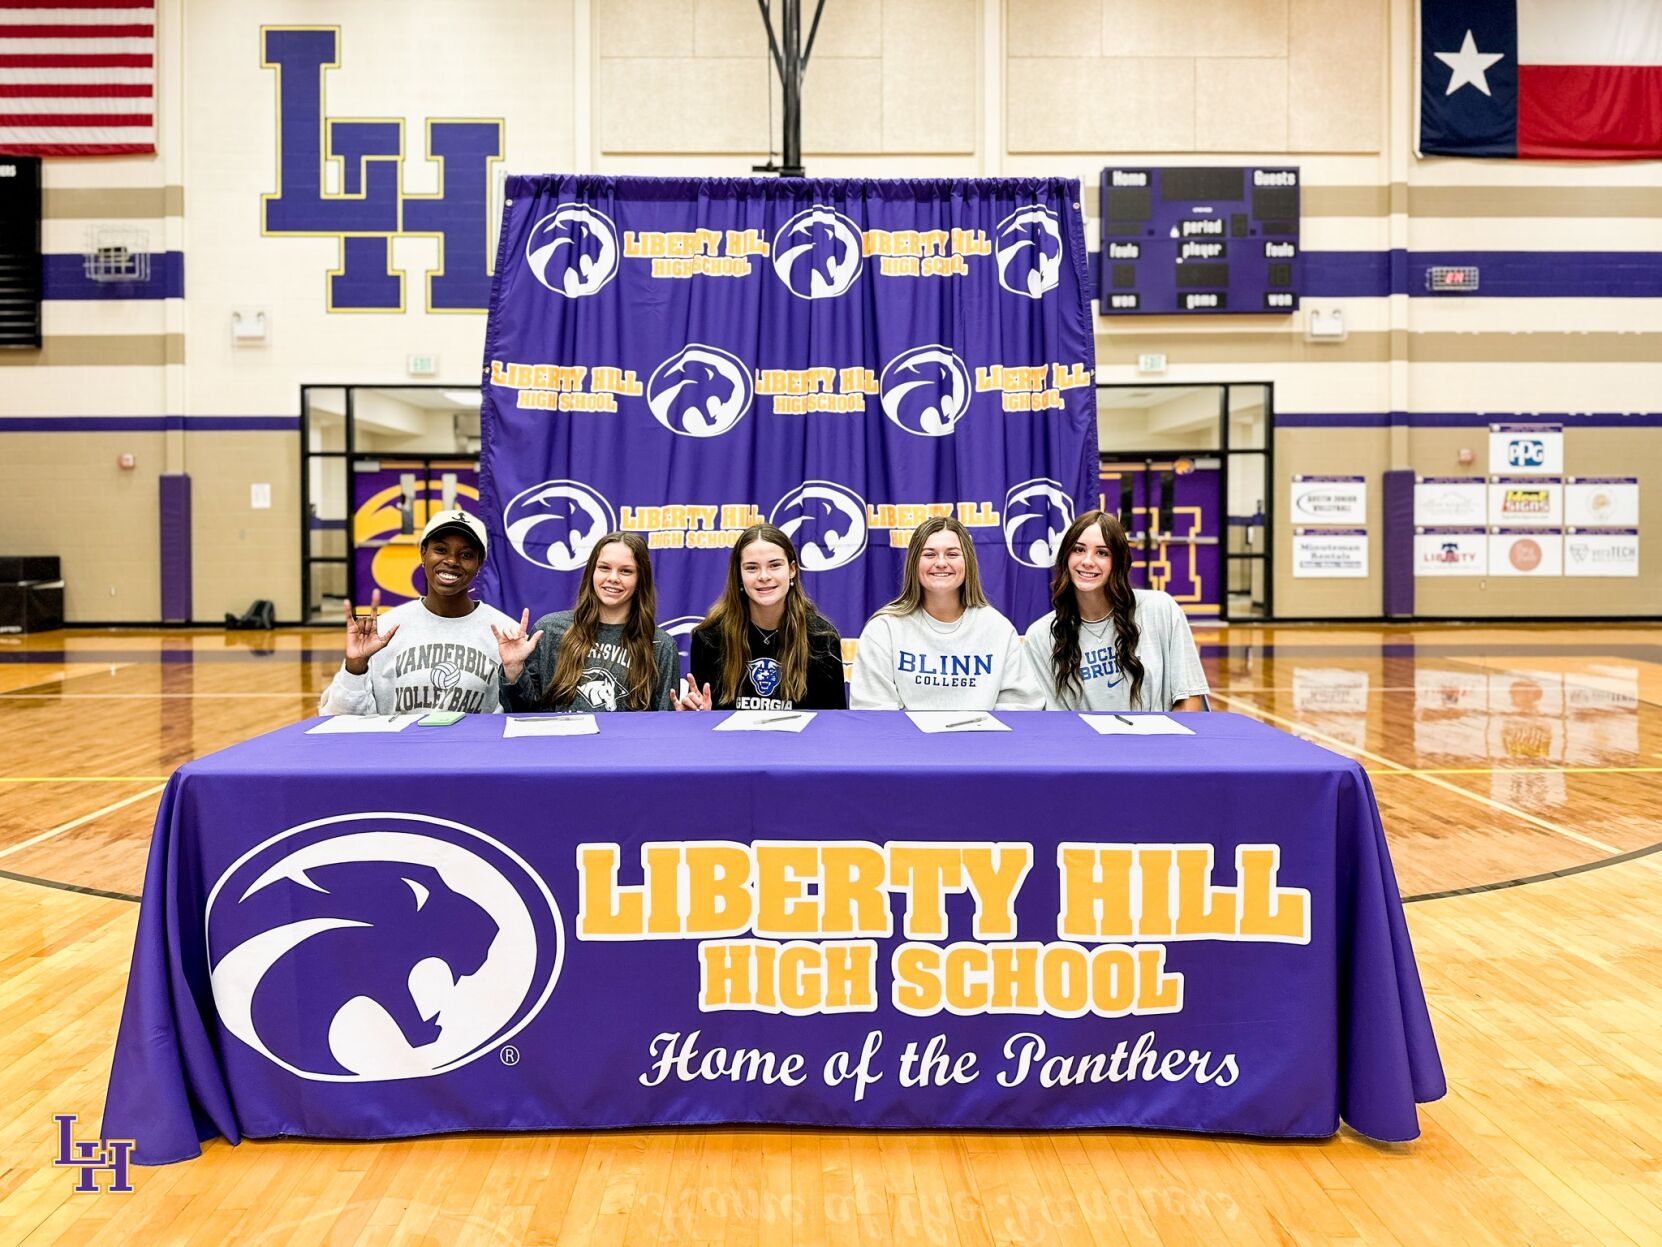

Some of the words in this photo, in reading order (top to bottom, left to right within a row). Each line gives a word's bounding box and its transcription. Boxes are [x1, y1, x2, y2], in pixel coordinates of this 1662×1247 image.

[259, 24, 504, 314] LH
[1183, 219, 1223, 238] period
[623, 228, 723, 259] LIBERTY
[1182, 240, 1223, 260] player
[651, 258, 694, 278] HIGH
[692, 254, 752, 277] SCHOOL
[880, 256, 920, 277] HIGH
[490, 360, 588, 392] LIBERTY
[590, 366, 644, 397] HILL
[516, 389, 558, 411] HIGH
[807, 392, 866, 414] SCHOOL
[1001, 391, 1032, 413] IGH
[1509, 439, 1544, 467] PPG
[620, 504, 719, 532] LIBERTY
[720, 503, 766, 530] HILL
[648, 530, 685, 550] HIGH
[685, 530, 746, 549] SCHOO
[1423, 552, 1476, 563] LIBTY
[396, 643, 499, 686] VANDERBILT
[898, 650, 994, 676] BLINN
[1085, 646, 1117, 665] UCL
[915, 675, 977, 687] COLLEGE
[395, 685, 486, 714] VOLLEYBALL
[735, 696, 793, 711] GEORGIA
[576, 840, 1034, 941] LIBERTY
[1057, 841, 1312, 946] HILL
[698, 938, 879, 1017] HIGH
[891, 941, 1184, 1019] SCHOOL
[638, 1029, 808, 1088] Home
[823, 1030, 884, 1103] of
[899, 1033, 980, 1088] the
[996, 1031, 1240, 1089] Panthers
